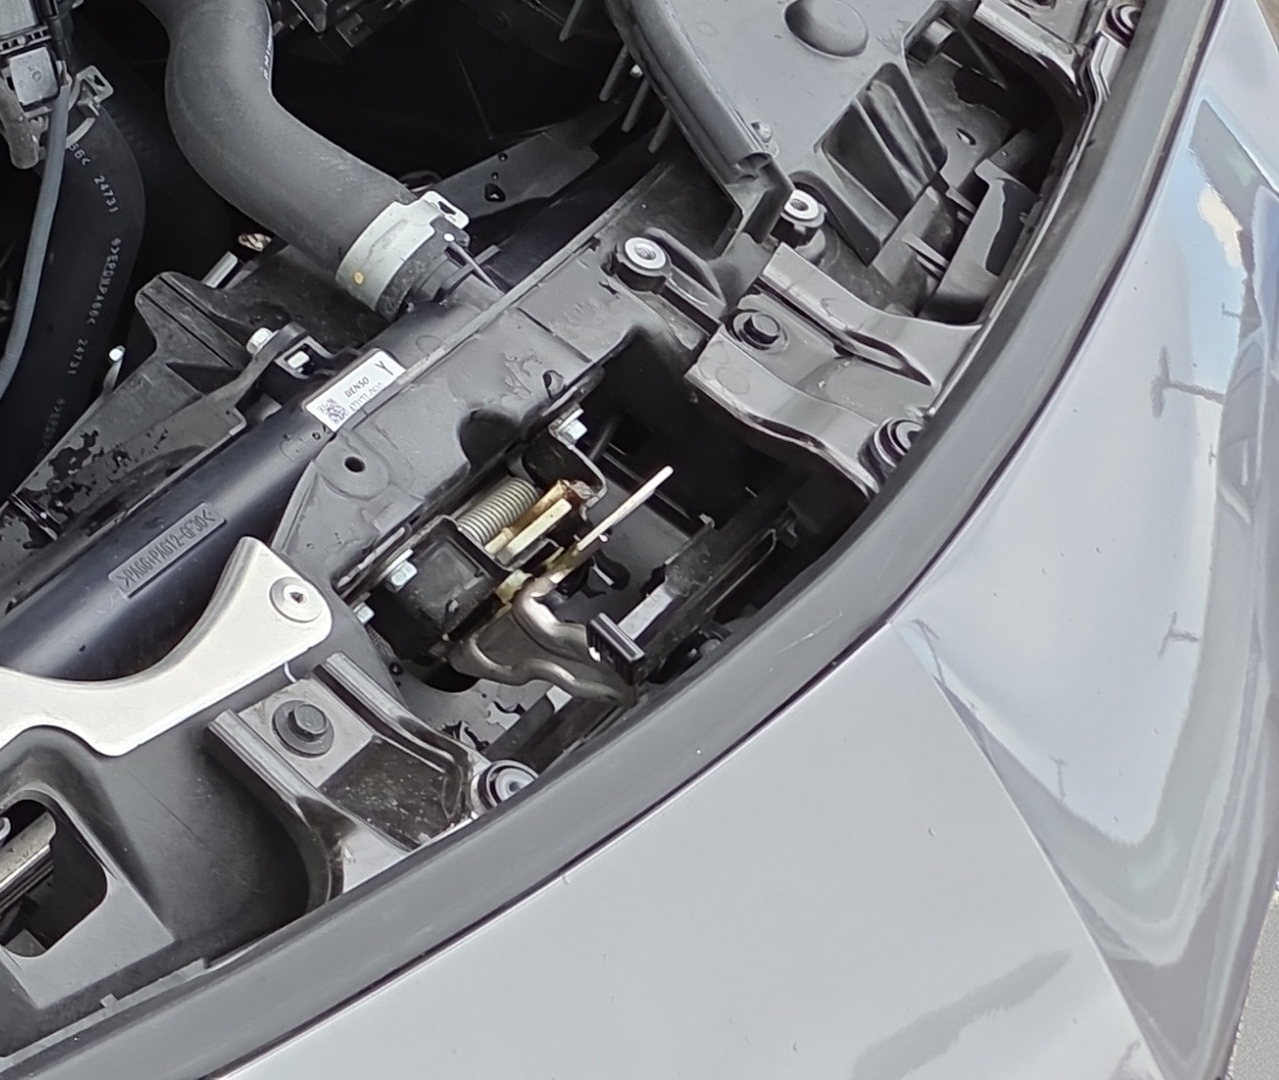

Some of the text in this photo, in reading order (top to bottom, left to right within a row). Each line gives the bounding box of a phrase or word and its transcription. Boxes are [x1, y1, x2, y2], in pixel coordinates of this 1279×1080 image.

[93, 174, 119, 213] 24731
[67, 338, 89, 375] 24731
[375, 360, 394, 376] Y
[344, 376, 370, 398] DENSO
